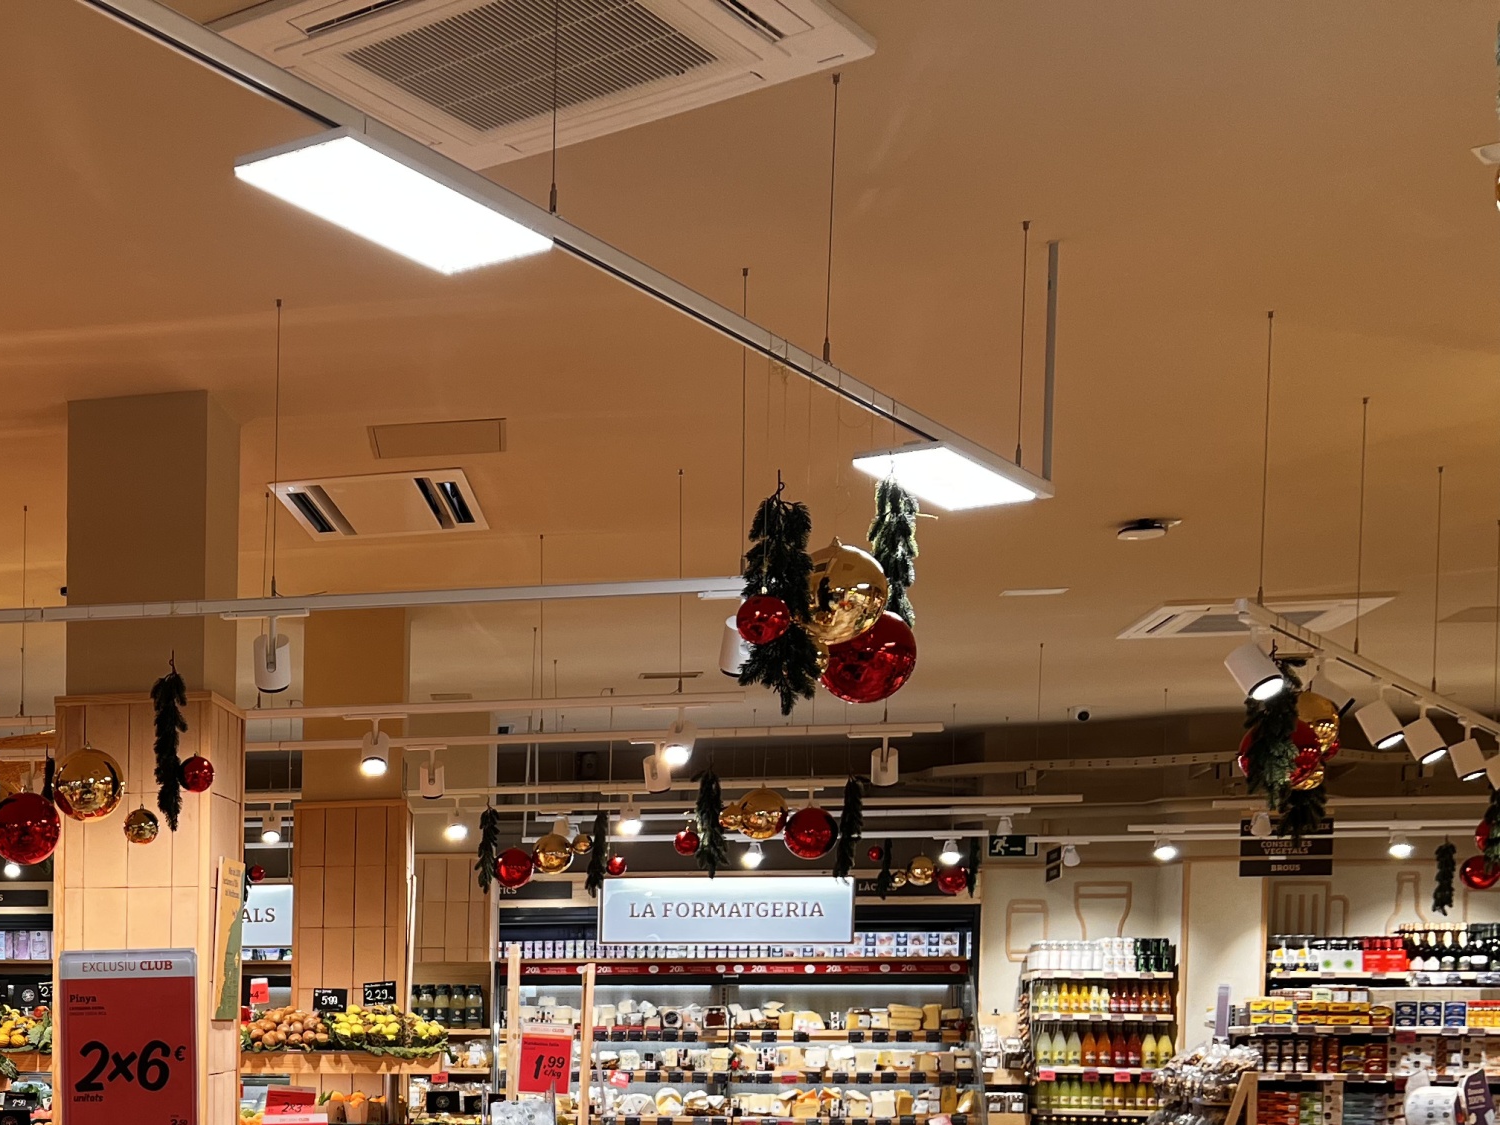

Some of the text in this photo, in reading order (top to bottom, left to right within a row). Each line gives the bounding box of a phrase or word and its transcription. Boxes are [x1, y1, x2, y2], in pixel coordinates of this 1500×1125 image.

[1263, 847, 1309, 855] VEGETALS
[1270, 863, 1301, 873] BROUS
[629, 901, 825, 919] LA FORMATGERIA
[82, 960, 173, 973] EXCLUSIU CLUB
[69, 994, 97, 1004] Pinya
